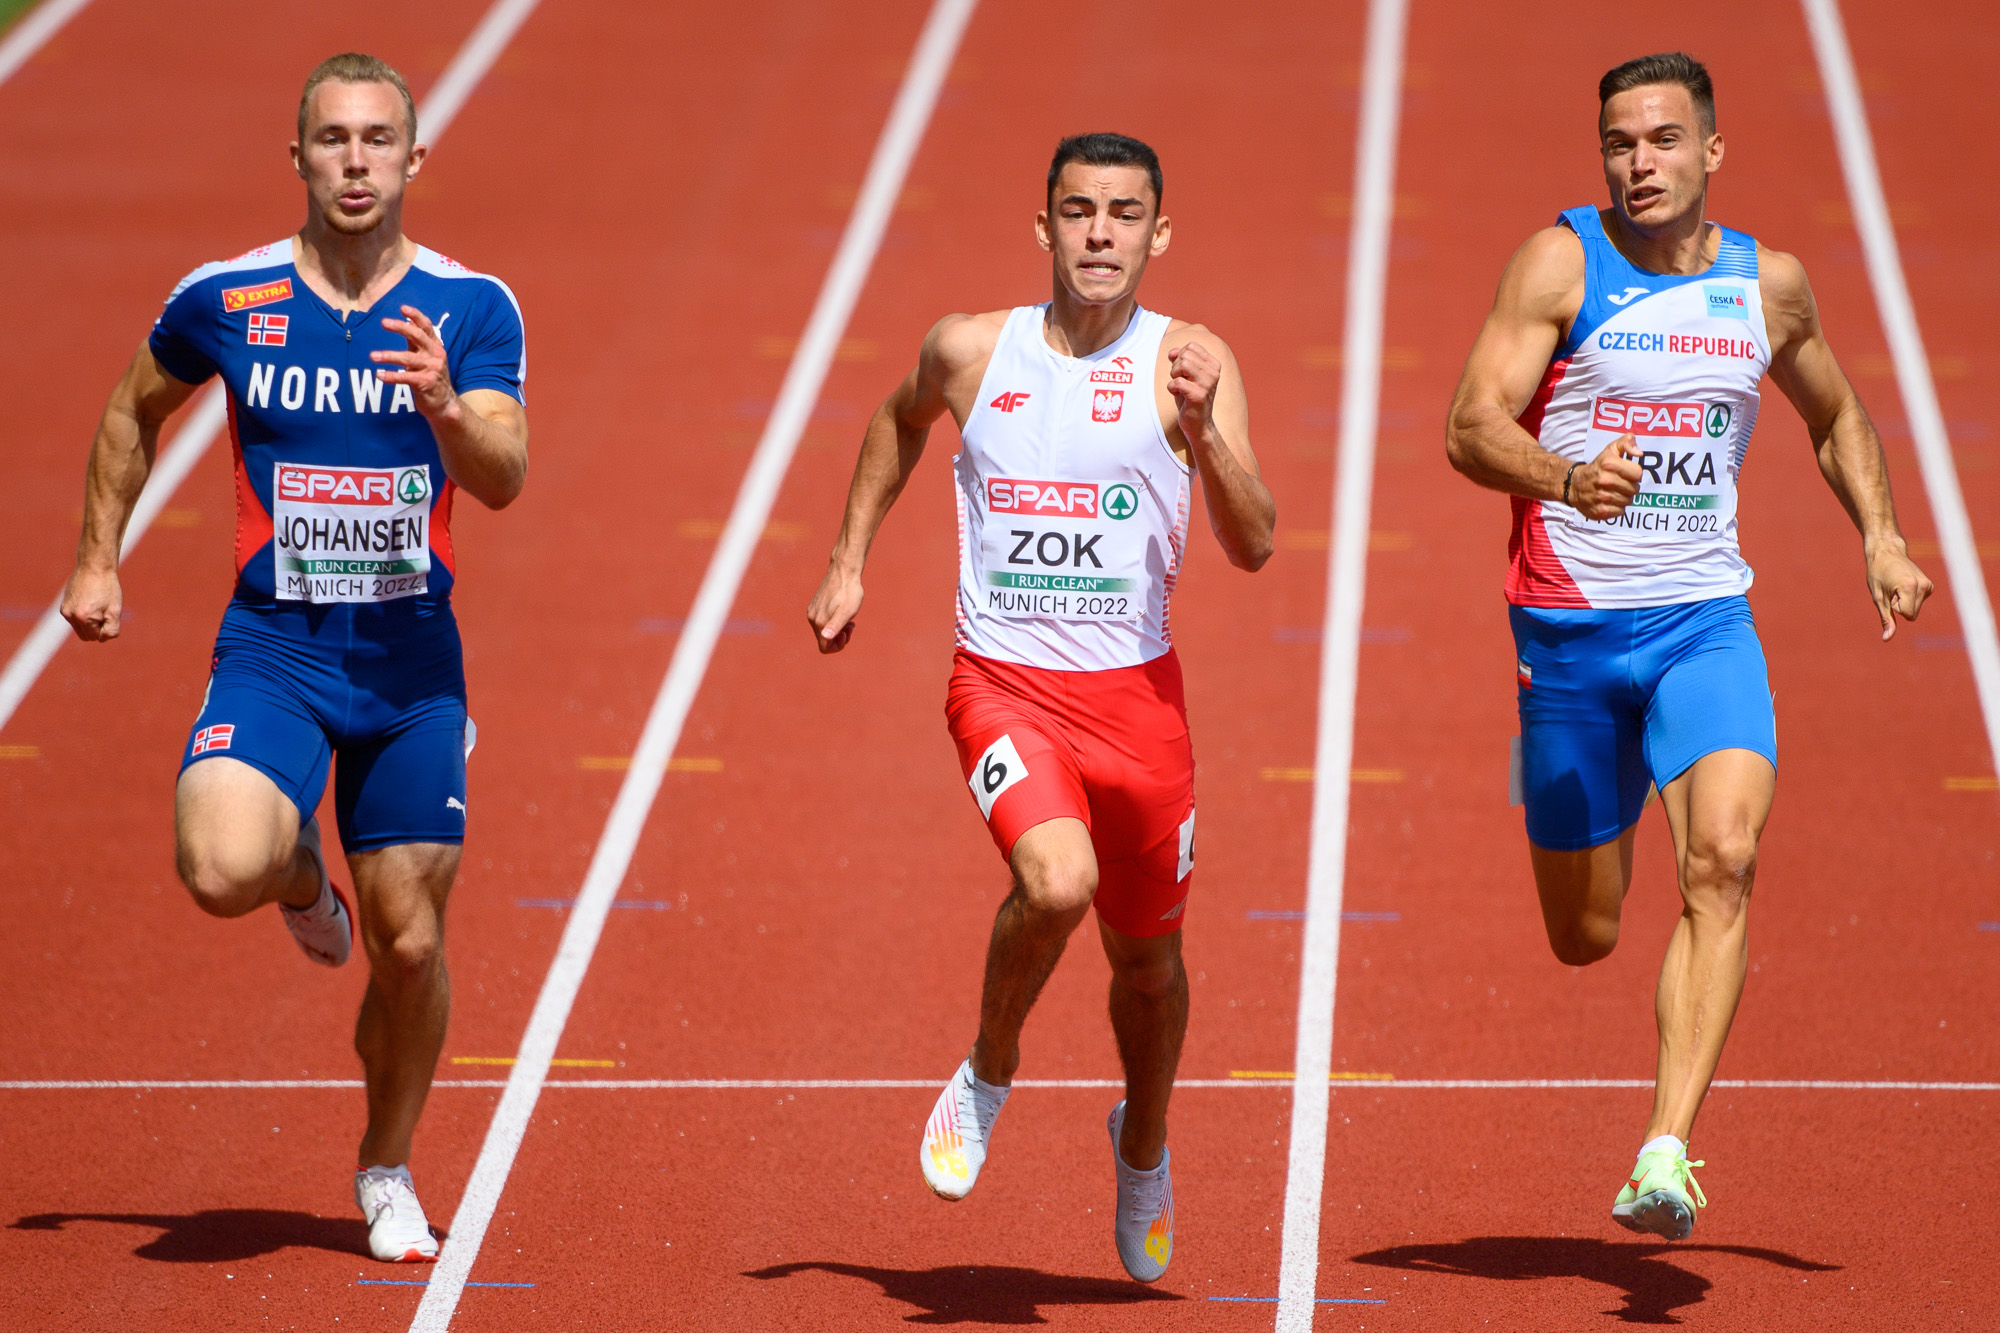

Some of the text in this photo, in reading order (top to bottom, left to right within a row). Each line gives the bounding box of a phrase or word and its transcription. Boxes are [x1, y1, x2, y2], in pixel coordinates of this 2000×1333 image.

[247, 285, 289, 302] EXTRA
[1598, 332, 1756, 360] CZECH REPUBLIC
[247, 362, 416, 414] NORWA
[1092, 372, 1132, 383] ORLEN
[990, 391, 1031, 413] 4F
[1596, 402, 1702, 433] SPAR
[1622, 450, 1717, 486] RKA
[281, 471, 392, 501] SPAR
[990, 483, 1096, 513] SPAR
[1632, 494, 1653, 507] UN
[278, 516, 423, 553] JOHANSEN
[1586, 511, 1718, 533] UNICH 2022
[1007, 530, 1104, 569] ZOK
[308, 562, 312, 574] I
[315, 561, 344, 574] RUN
[287, 576, 423, 597] MUNICH 2022
[1011, 574, 1015, 586] I
[1018, 575, 1049, 588] RUN
[989, 591, 1128, 615] MUNICH 2022
[983, 751, 1008, 794] 6
